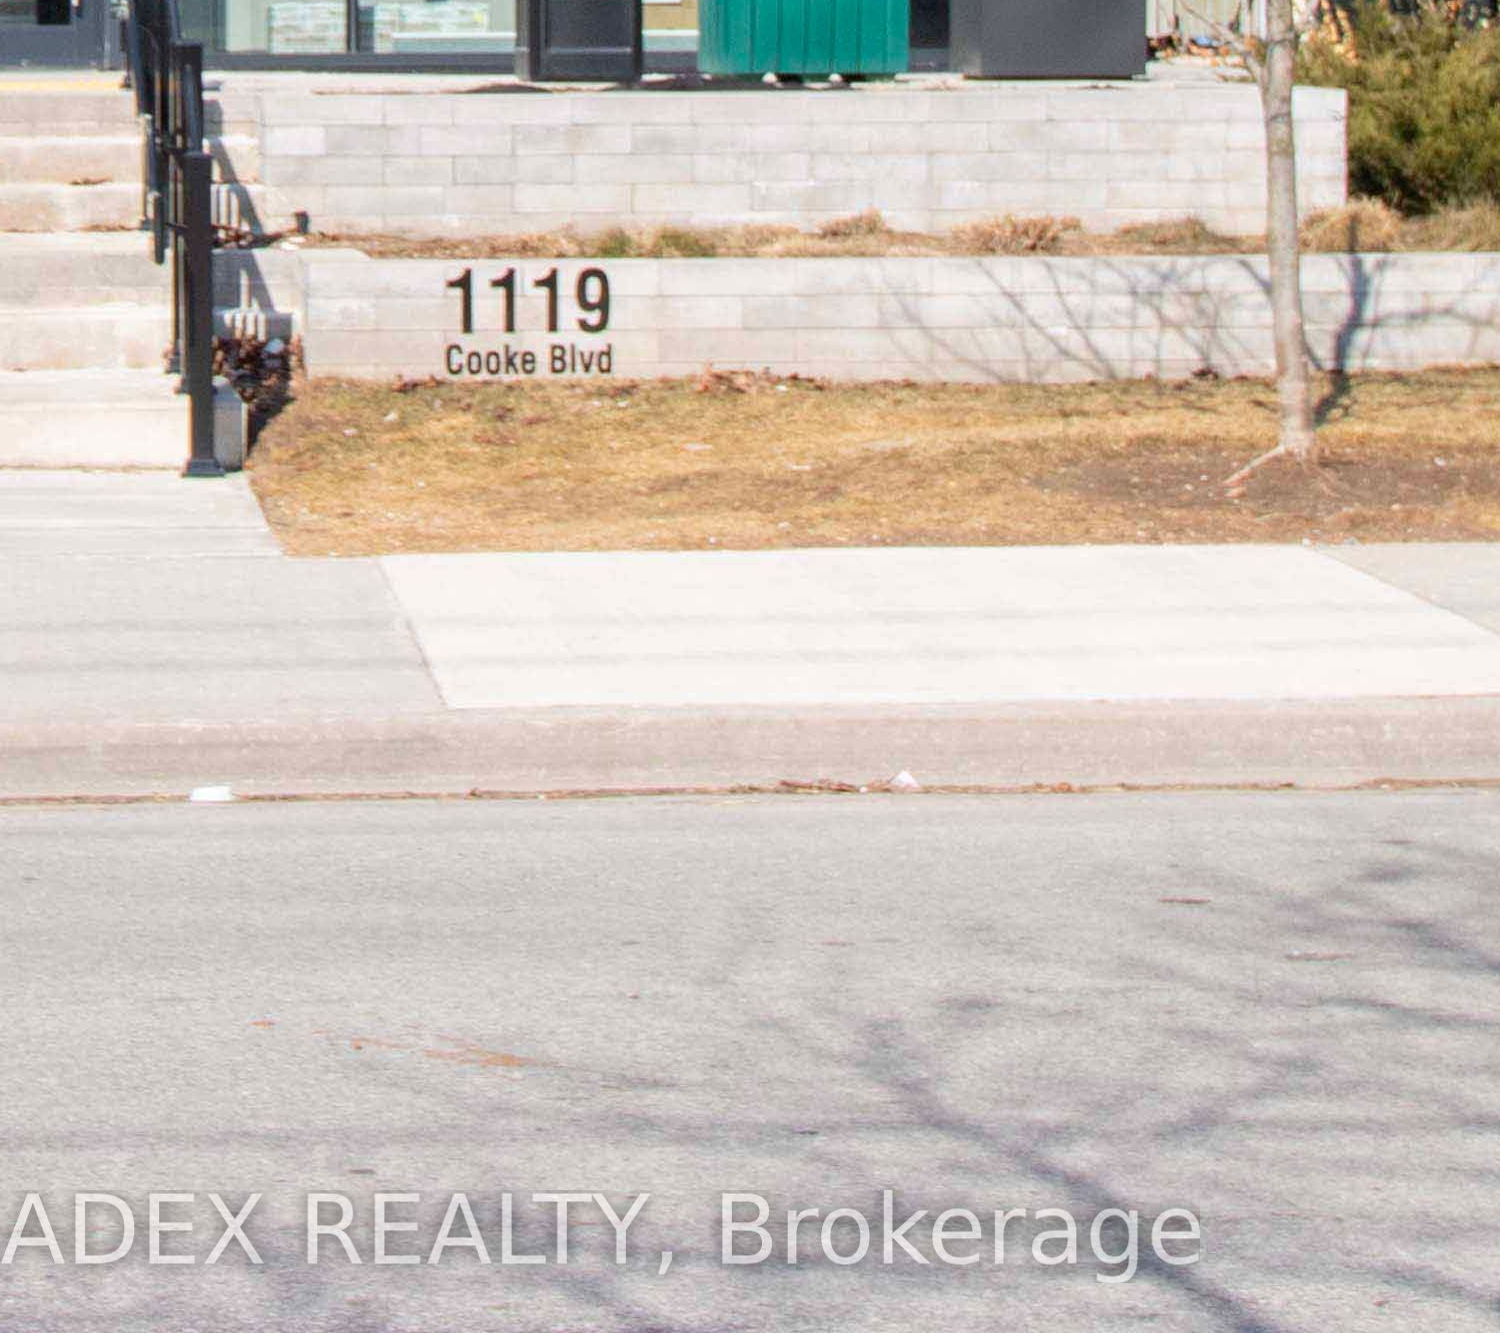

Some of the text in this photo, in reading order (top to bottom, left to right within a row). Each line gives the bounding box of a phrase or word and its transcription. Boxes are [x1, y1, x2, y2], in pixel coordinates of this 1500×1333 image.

[446, 267, 610, 333] 1119
[446, 344, 612, 374] Cooke Blvd
